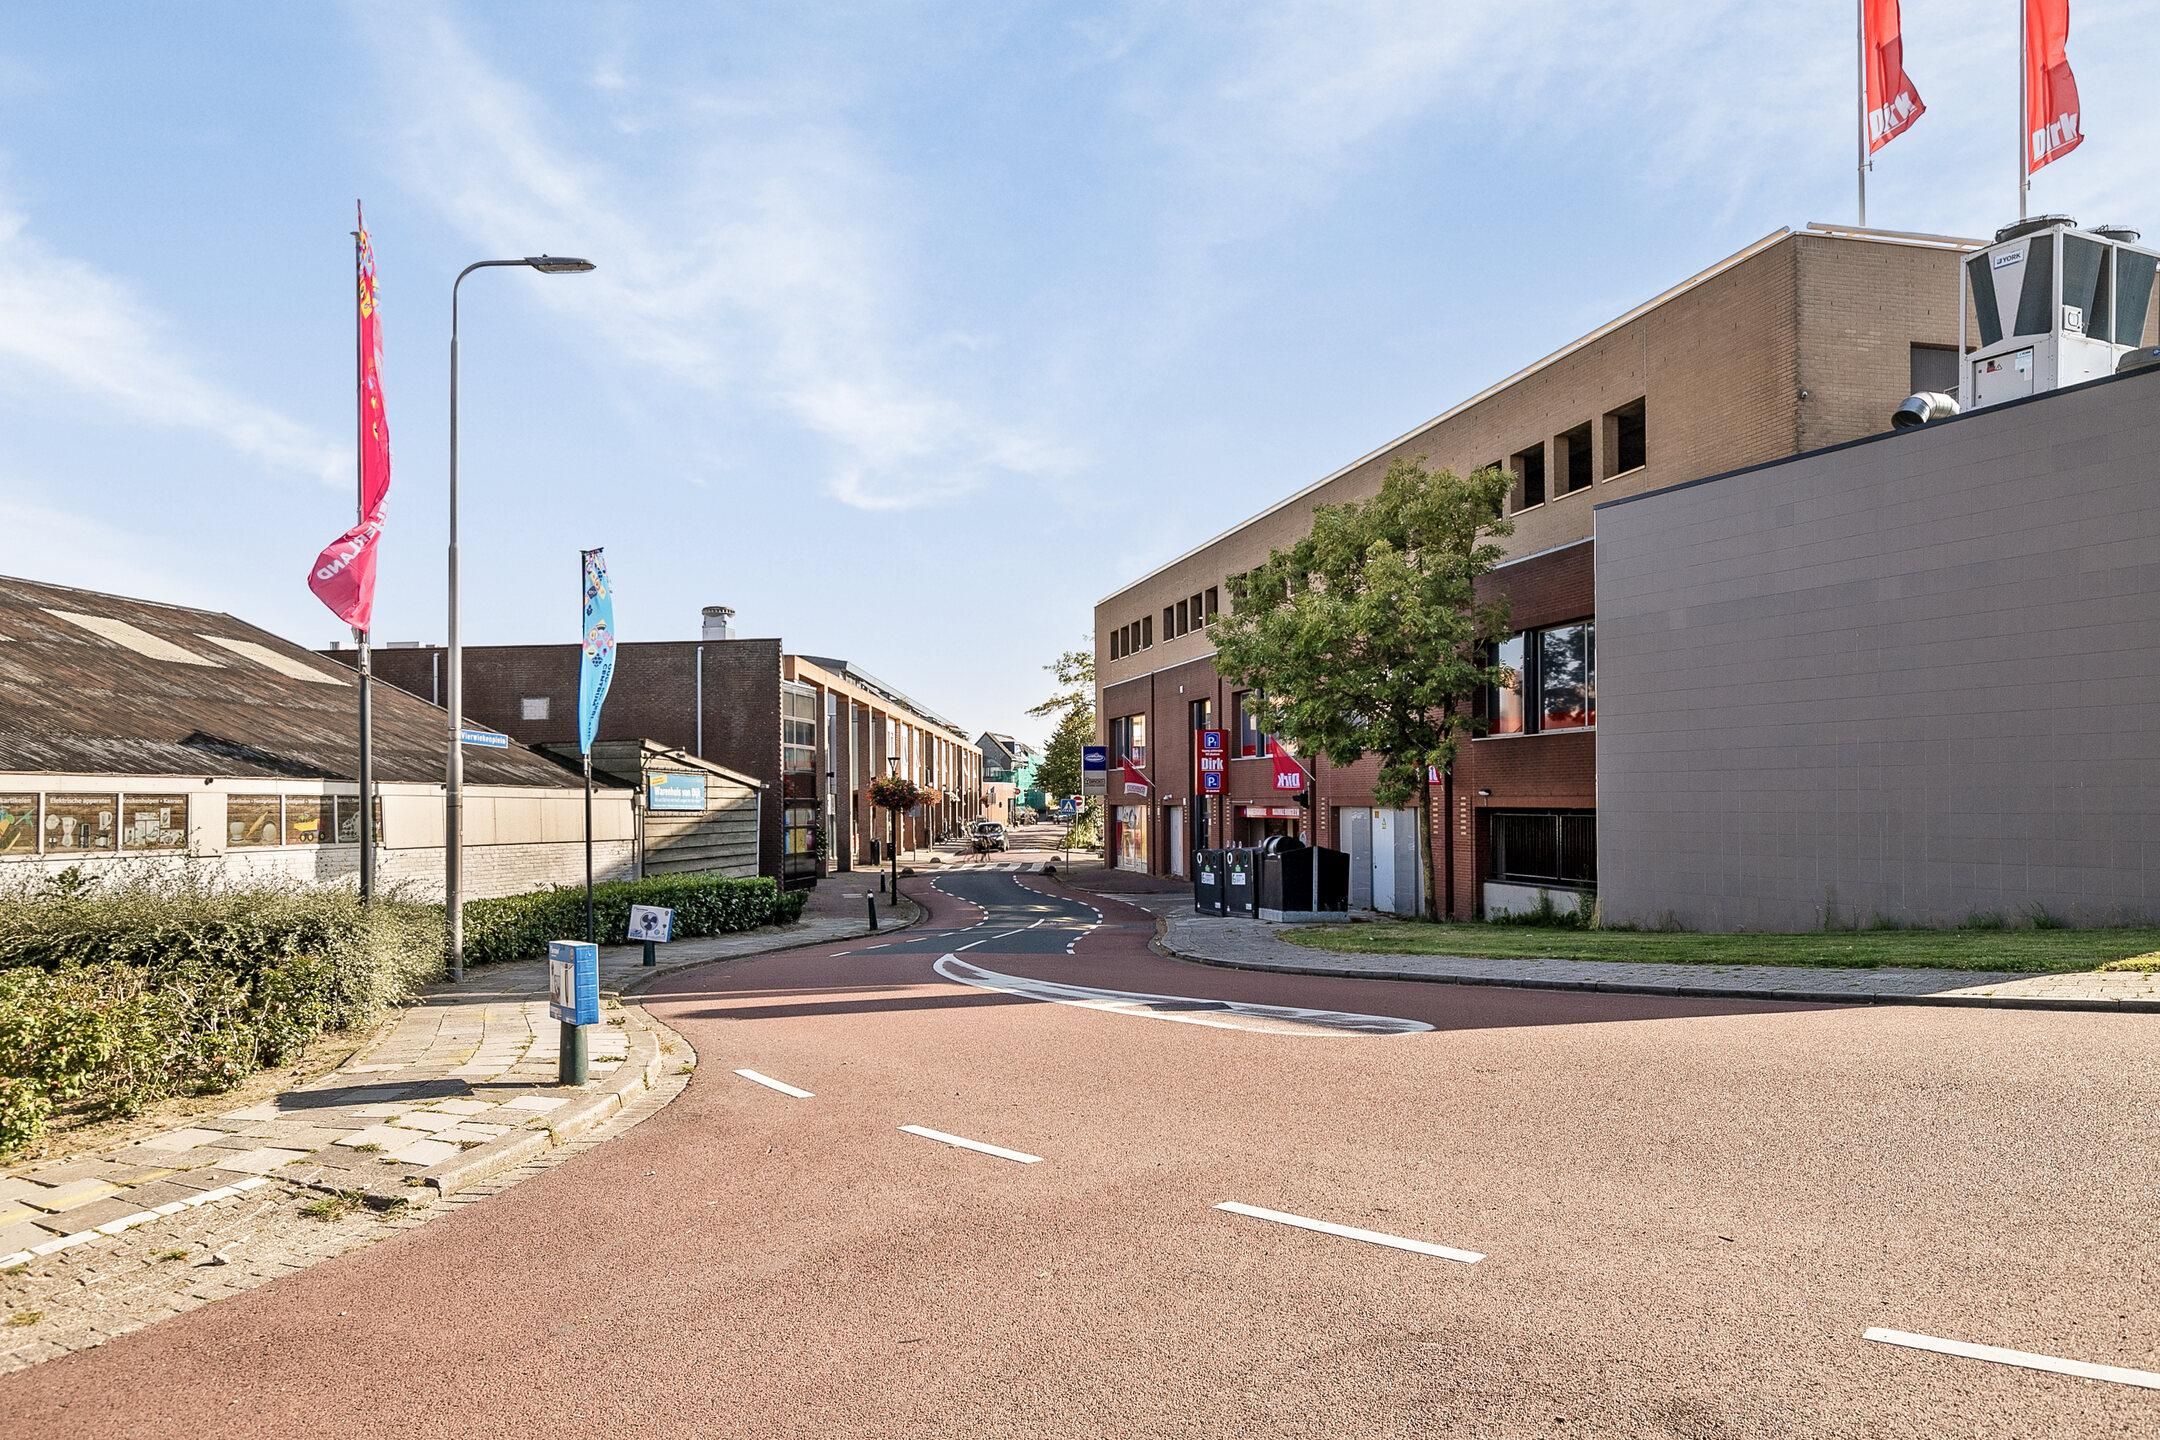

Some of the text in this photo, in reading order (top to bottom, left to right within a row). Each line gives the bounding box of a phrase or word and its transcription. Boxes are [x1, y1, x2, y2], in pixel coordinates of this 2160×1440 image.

[1869, 91, 1916, 140] Dirk
[2032, 112, 2078, 161] Dirk
[2002, 252, 2021, 262] YORK
[1201, 757, 1224, 770] Dirk
